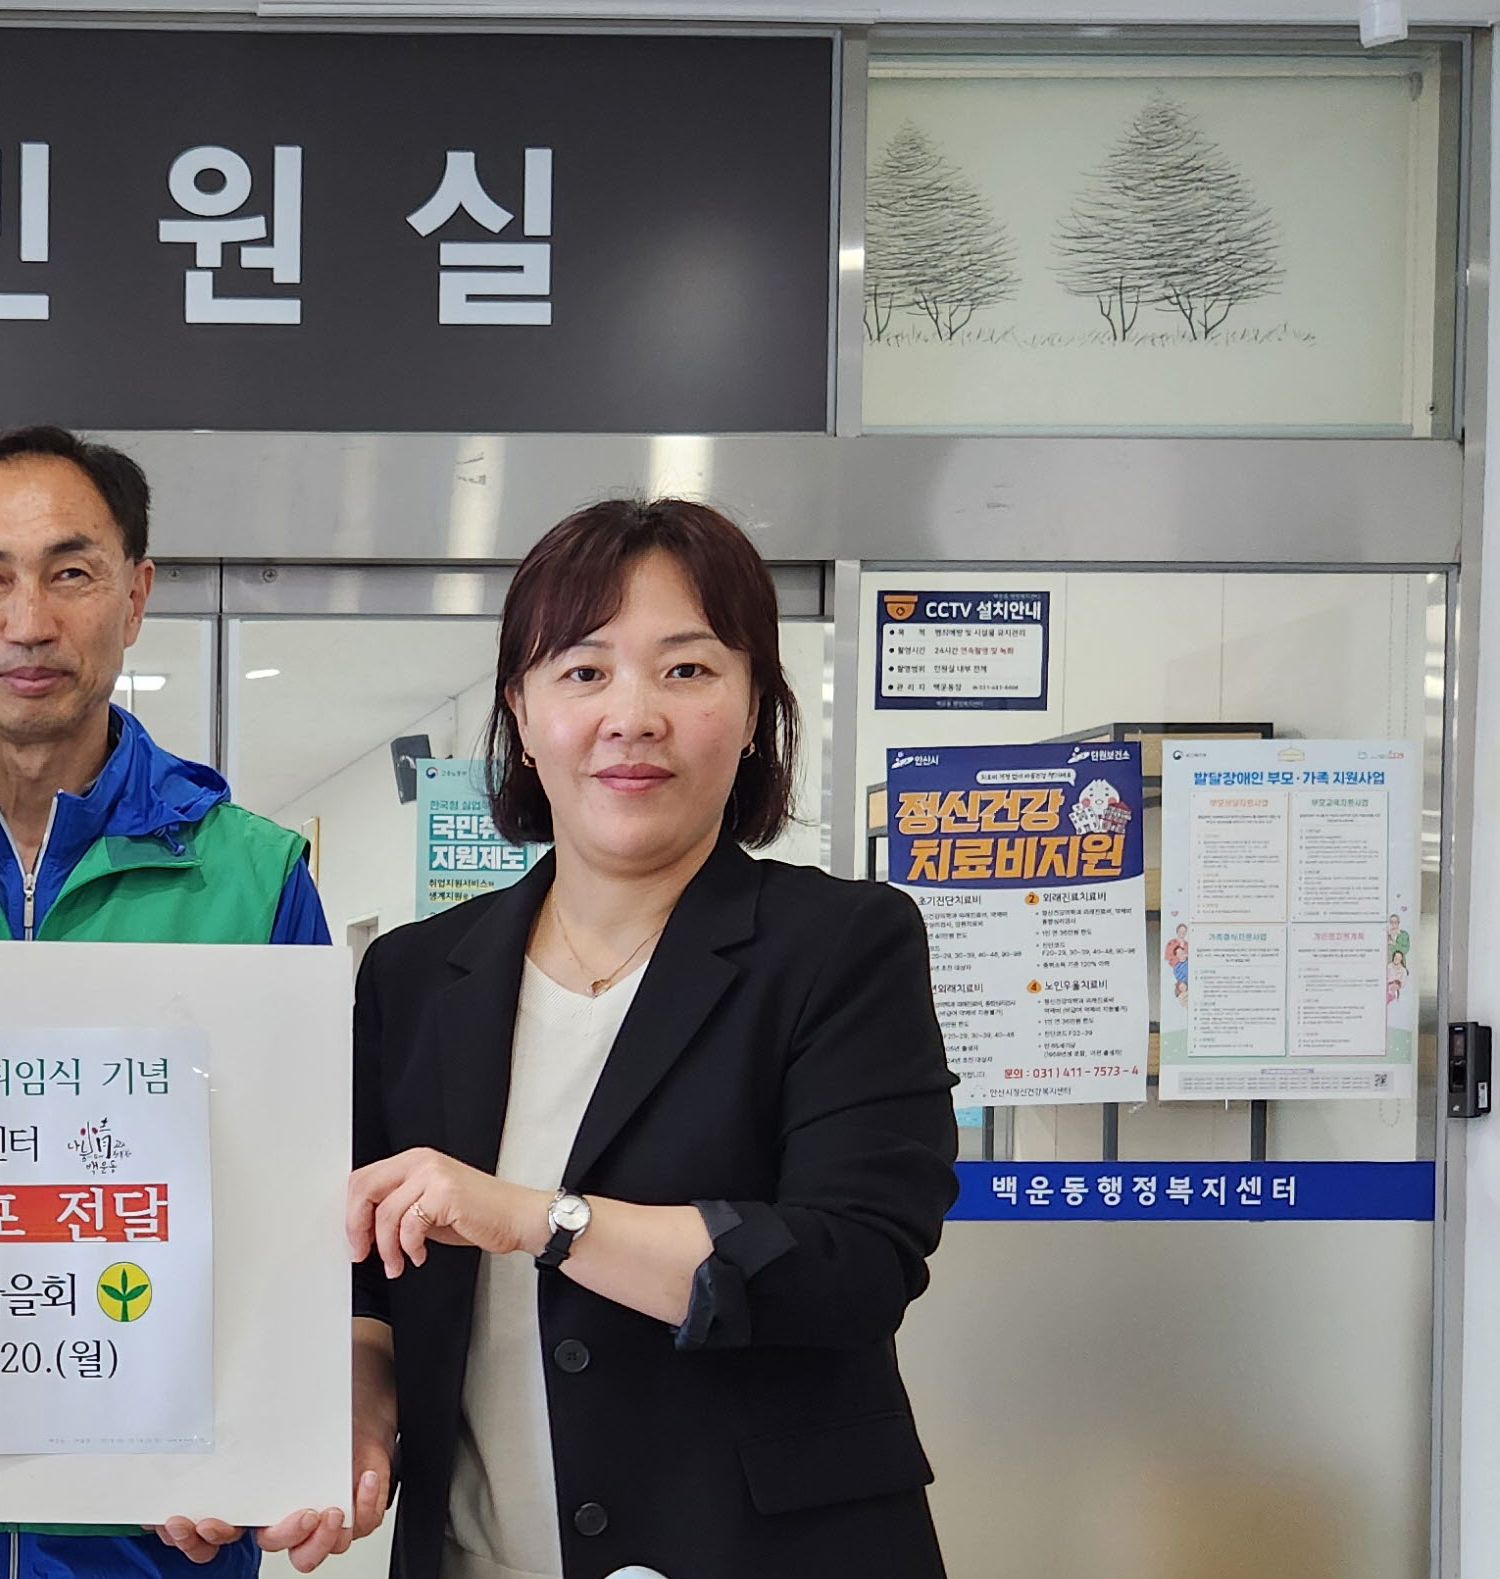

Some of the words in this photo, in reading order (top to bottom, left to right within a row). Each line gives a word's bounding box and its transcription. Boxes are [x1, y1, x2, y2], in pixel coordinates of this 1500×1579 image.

[925, 602, 972, 618] CCTV
[976, 600, 1041, 620] 설치안내
[934, 646, 959, 656] 24시간
[933, 664, 955, 674] 민원실
[913, 754, 939, 766] 안산시
[1090, 749, 1131, 761] 단원보건소
[1193, 771, 1264, 786] 발달장애인
[1332, 770, 1385, 786] 지원사업
[430, 799, 459, 811] 한국형
[895, 789, 1066, 836] 정신건강
[431, 844, 526, 870] 지원제도
[906, 834, 1126, 883] 치료비지원
[918, 895, 982, 906] 초기진단치료비
[1042, 891, 1107, 903] 외래진료치료비
[1044, 980, 1108, 991] 노인우울치료비
[102, 1058, 171, 1096] 기념
[1004, 1069, 1023, 1079] 문의
[991, 1174, 1298, 1206] 백운동행정복지센터
[57, 1188, 169, 1243] 전달
[0, 1337, 121, 1381] 20.(월)
